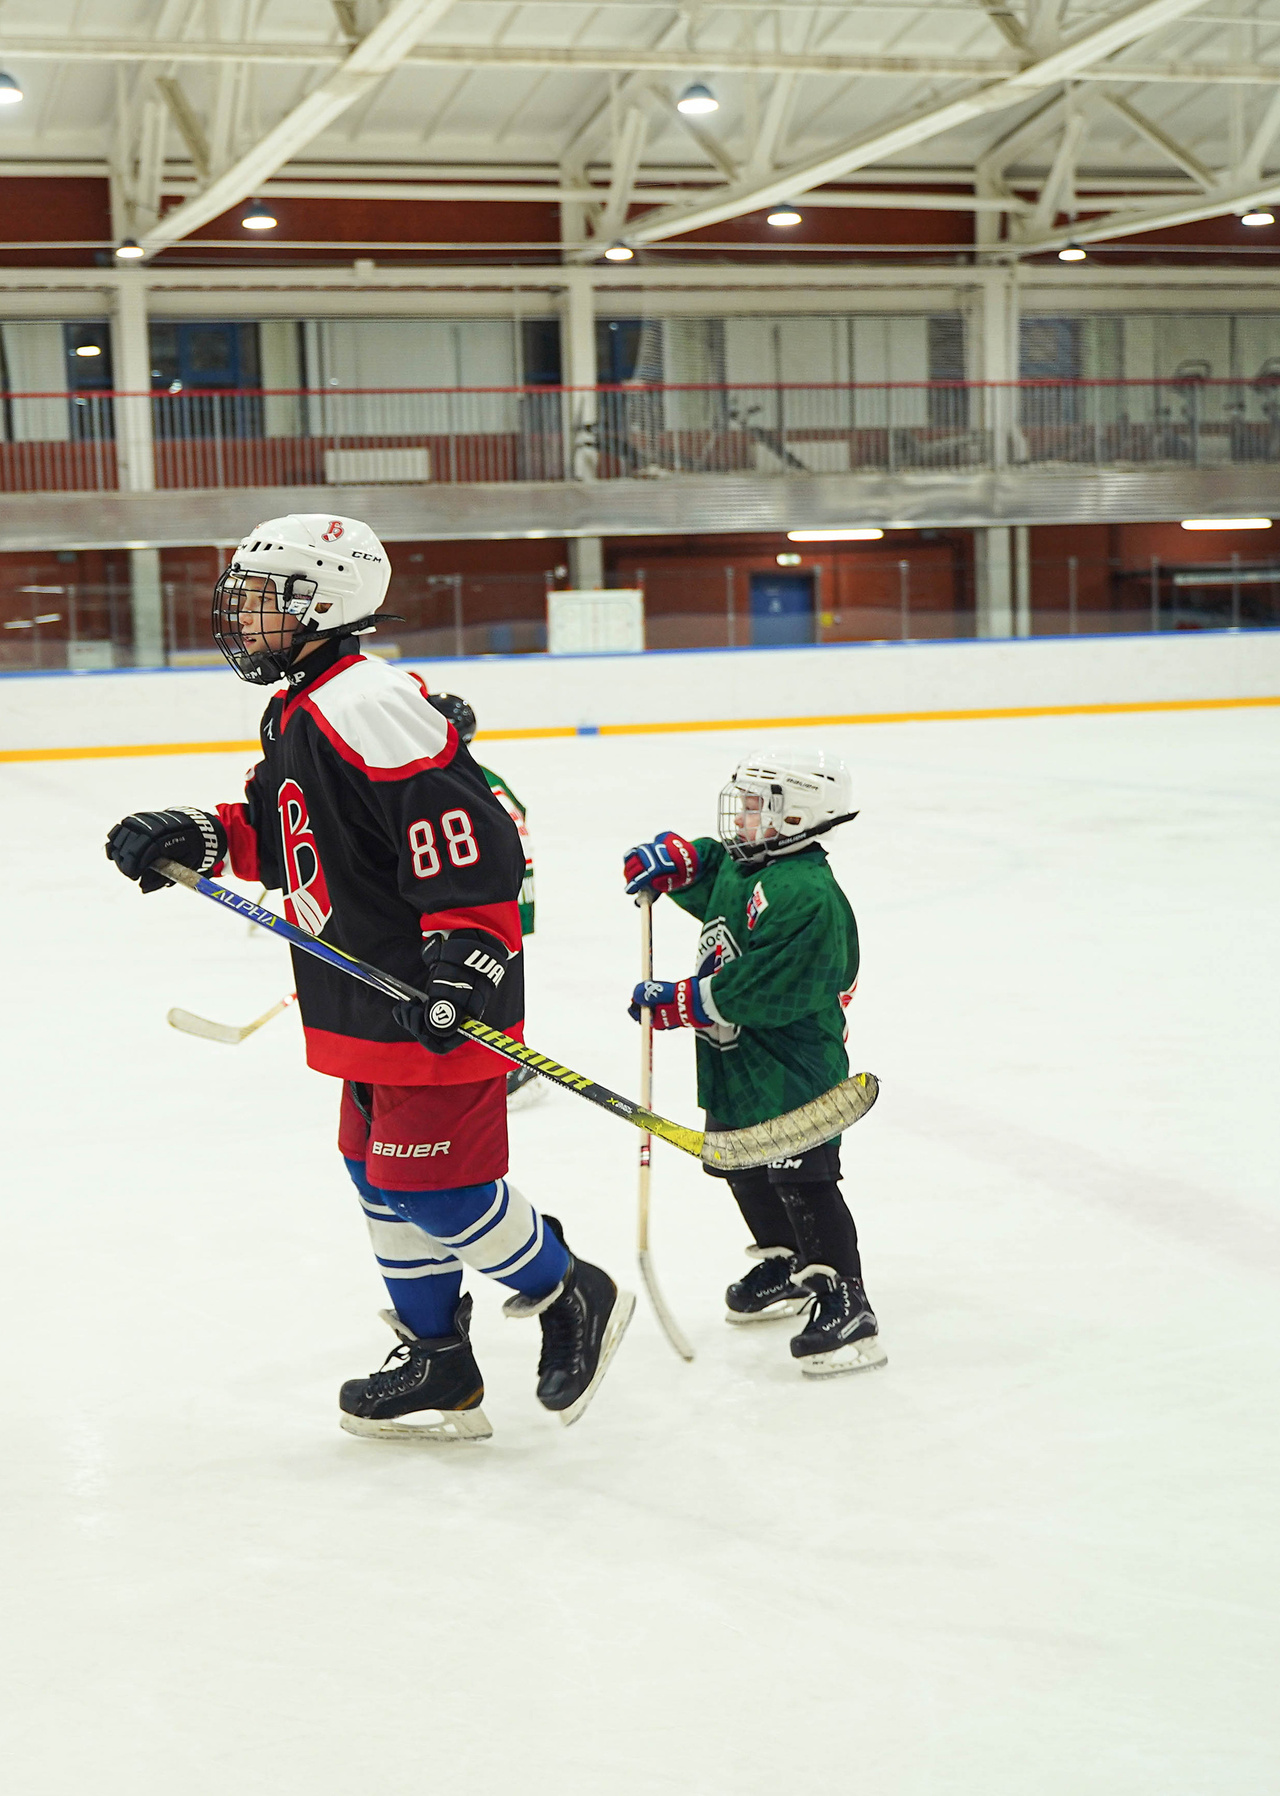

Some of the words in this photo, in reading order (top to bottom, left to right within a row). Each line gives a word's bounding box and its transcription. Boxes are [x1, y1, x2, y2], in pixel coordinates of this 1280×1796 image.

[351, 550, 382, 564] CCM
[166, 806, 219, 873] ARRIO
[407, 807, 481, 880] 88
[211, 889, 278, 928] ALPHA
[463, 949, 505, 989] WA
[460, 1015, 595, 1091] ARRIOR
